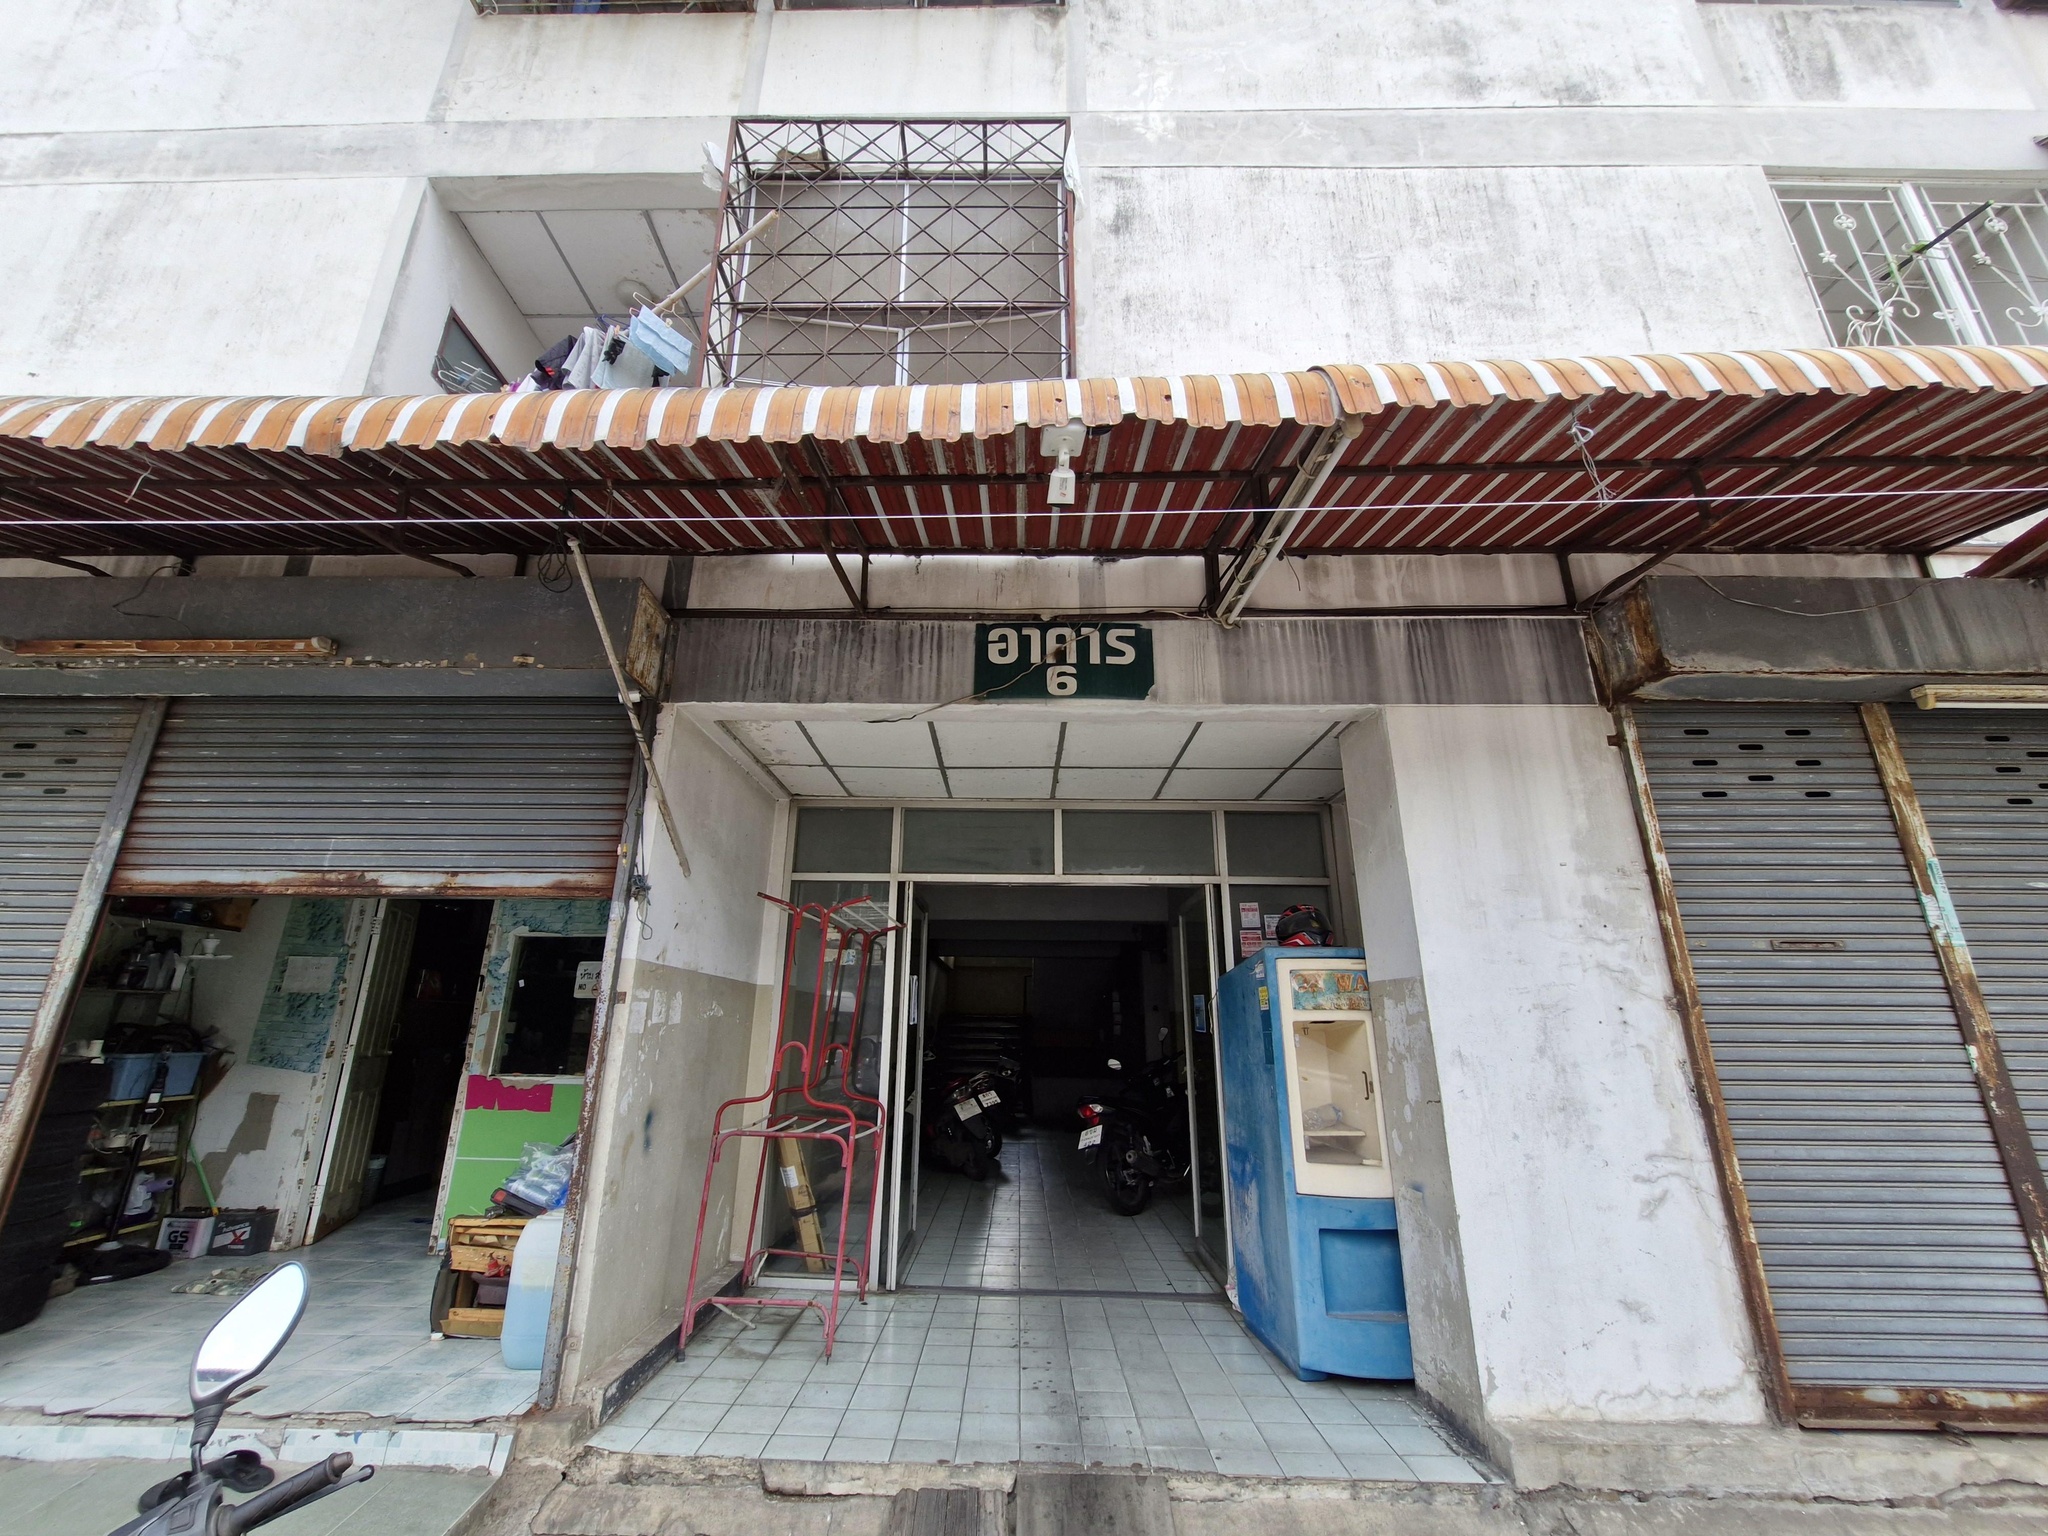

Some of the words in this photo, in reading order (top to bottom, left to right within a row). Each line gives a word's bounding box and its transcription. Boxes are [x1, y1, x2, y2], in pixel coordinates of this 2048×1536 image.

[988, 626, 1136, 665] อาคาร
[1046, 665, 1078, 696] 6
[167, 1230, 189, 1244] GS
